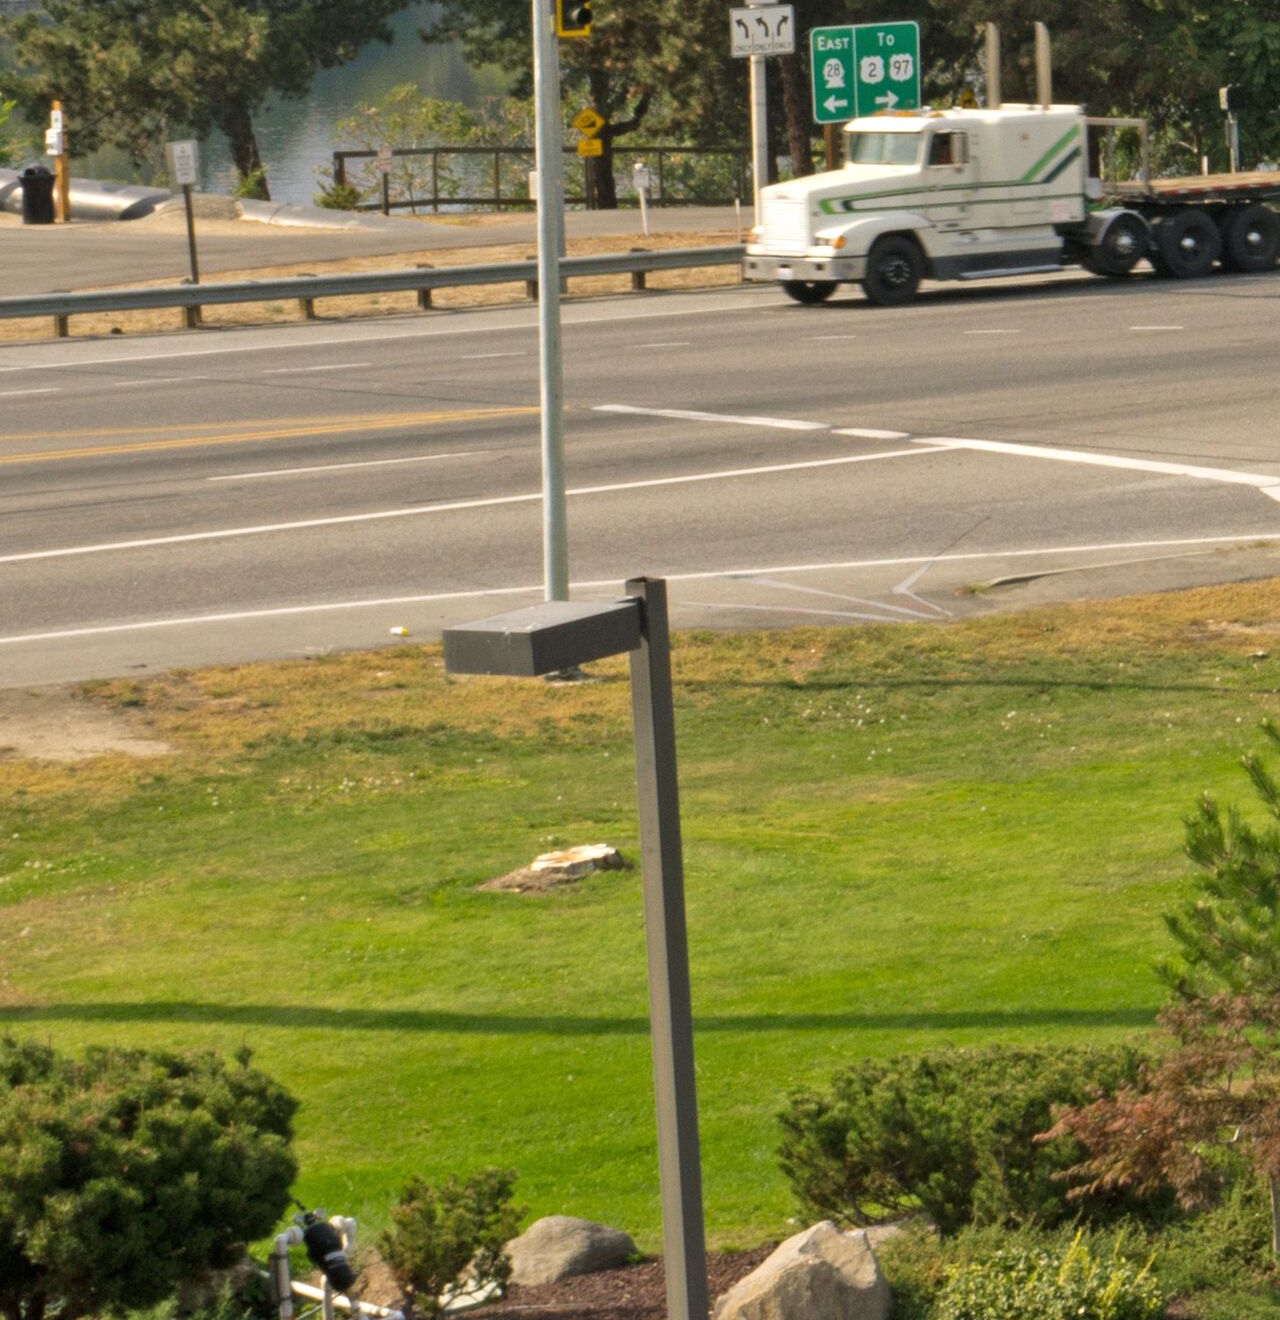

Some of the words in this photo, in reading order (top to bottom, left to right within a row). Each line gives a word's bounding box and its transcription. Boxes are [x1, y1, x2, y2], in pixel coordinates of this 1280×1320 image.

[817, 36, 850, 51] EAST
[826, 63, 841, 78] 28
[868, 62, 877, 78] 2
[893, 59, 910, 75] 97
